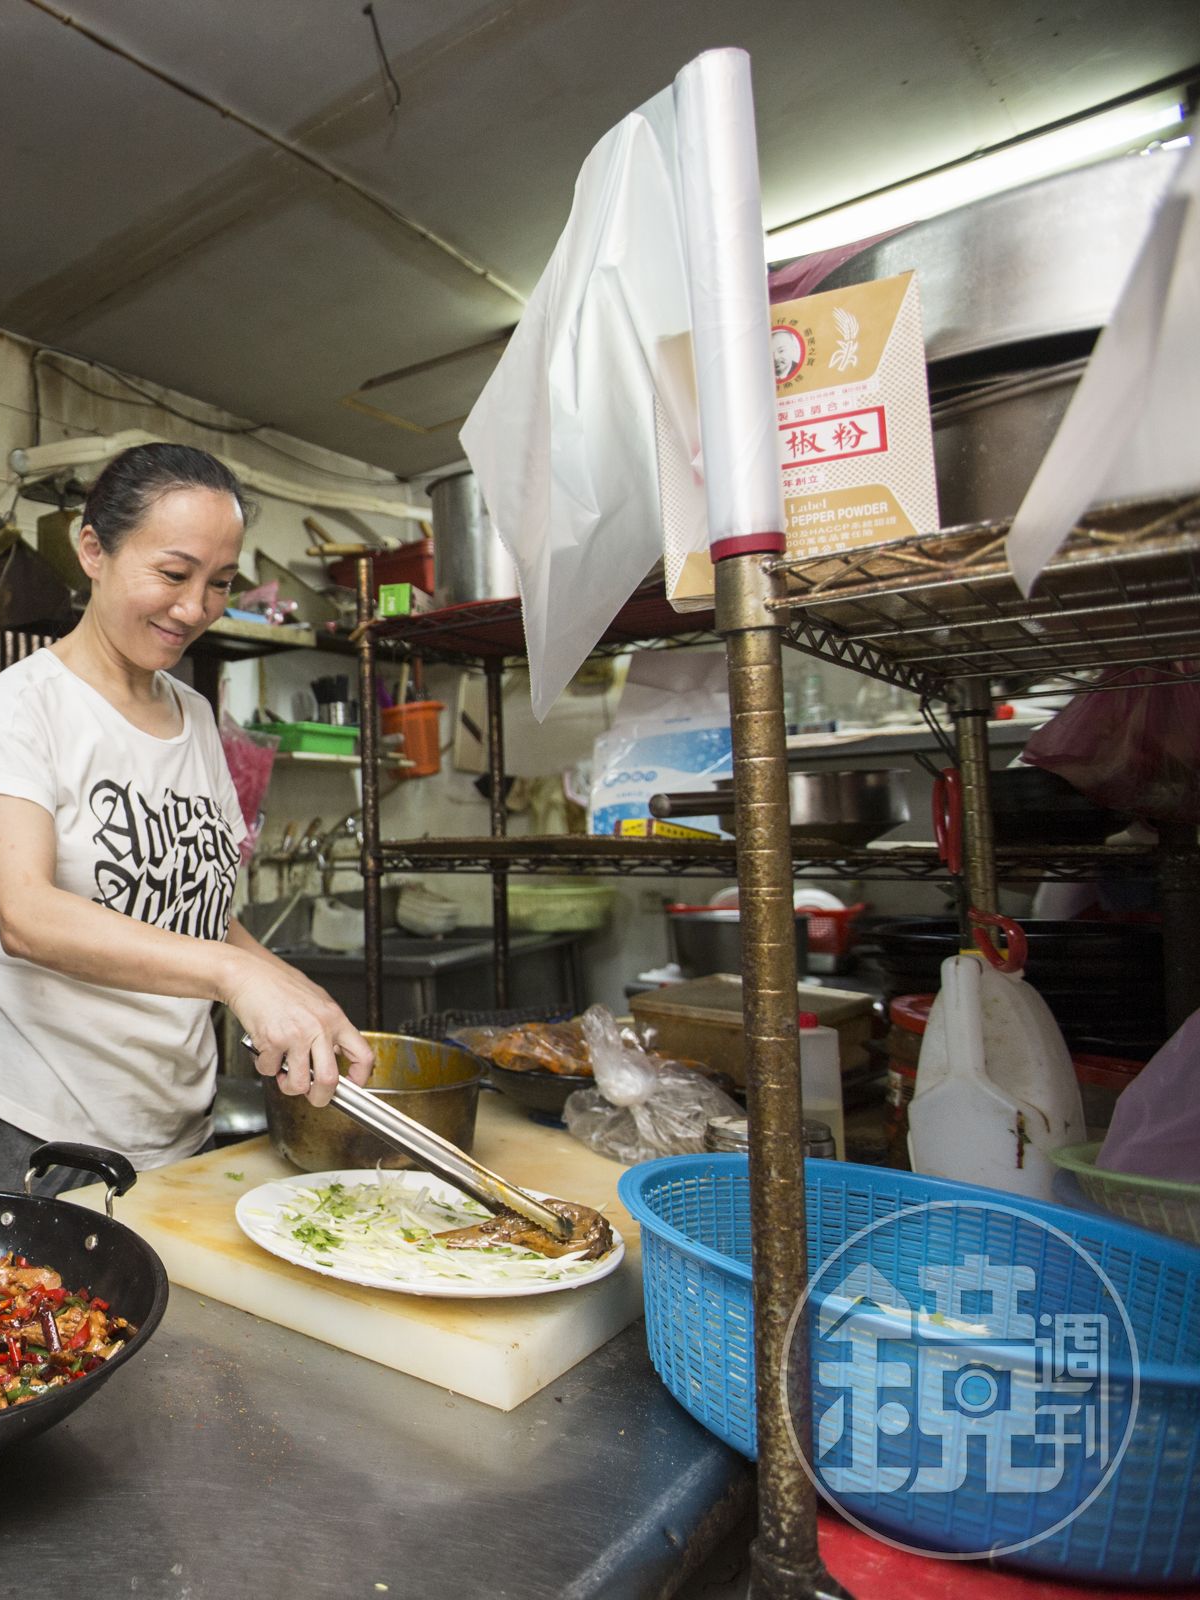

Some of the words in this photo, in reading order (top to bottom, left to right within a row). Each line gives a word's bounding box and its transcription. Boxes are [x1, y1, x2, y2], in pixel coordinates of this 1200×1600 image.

[785, 421, 868, 458] 椒粉
[790, 498, 827, 513] Label
[791, 510, 835, 528] PEPPER
[837, 501, 889, 520] POWDER
